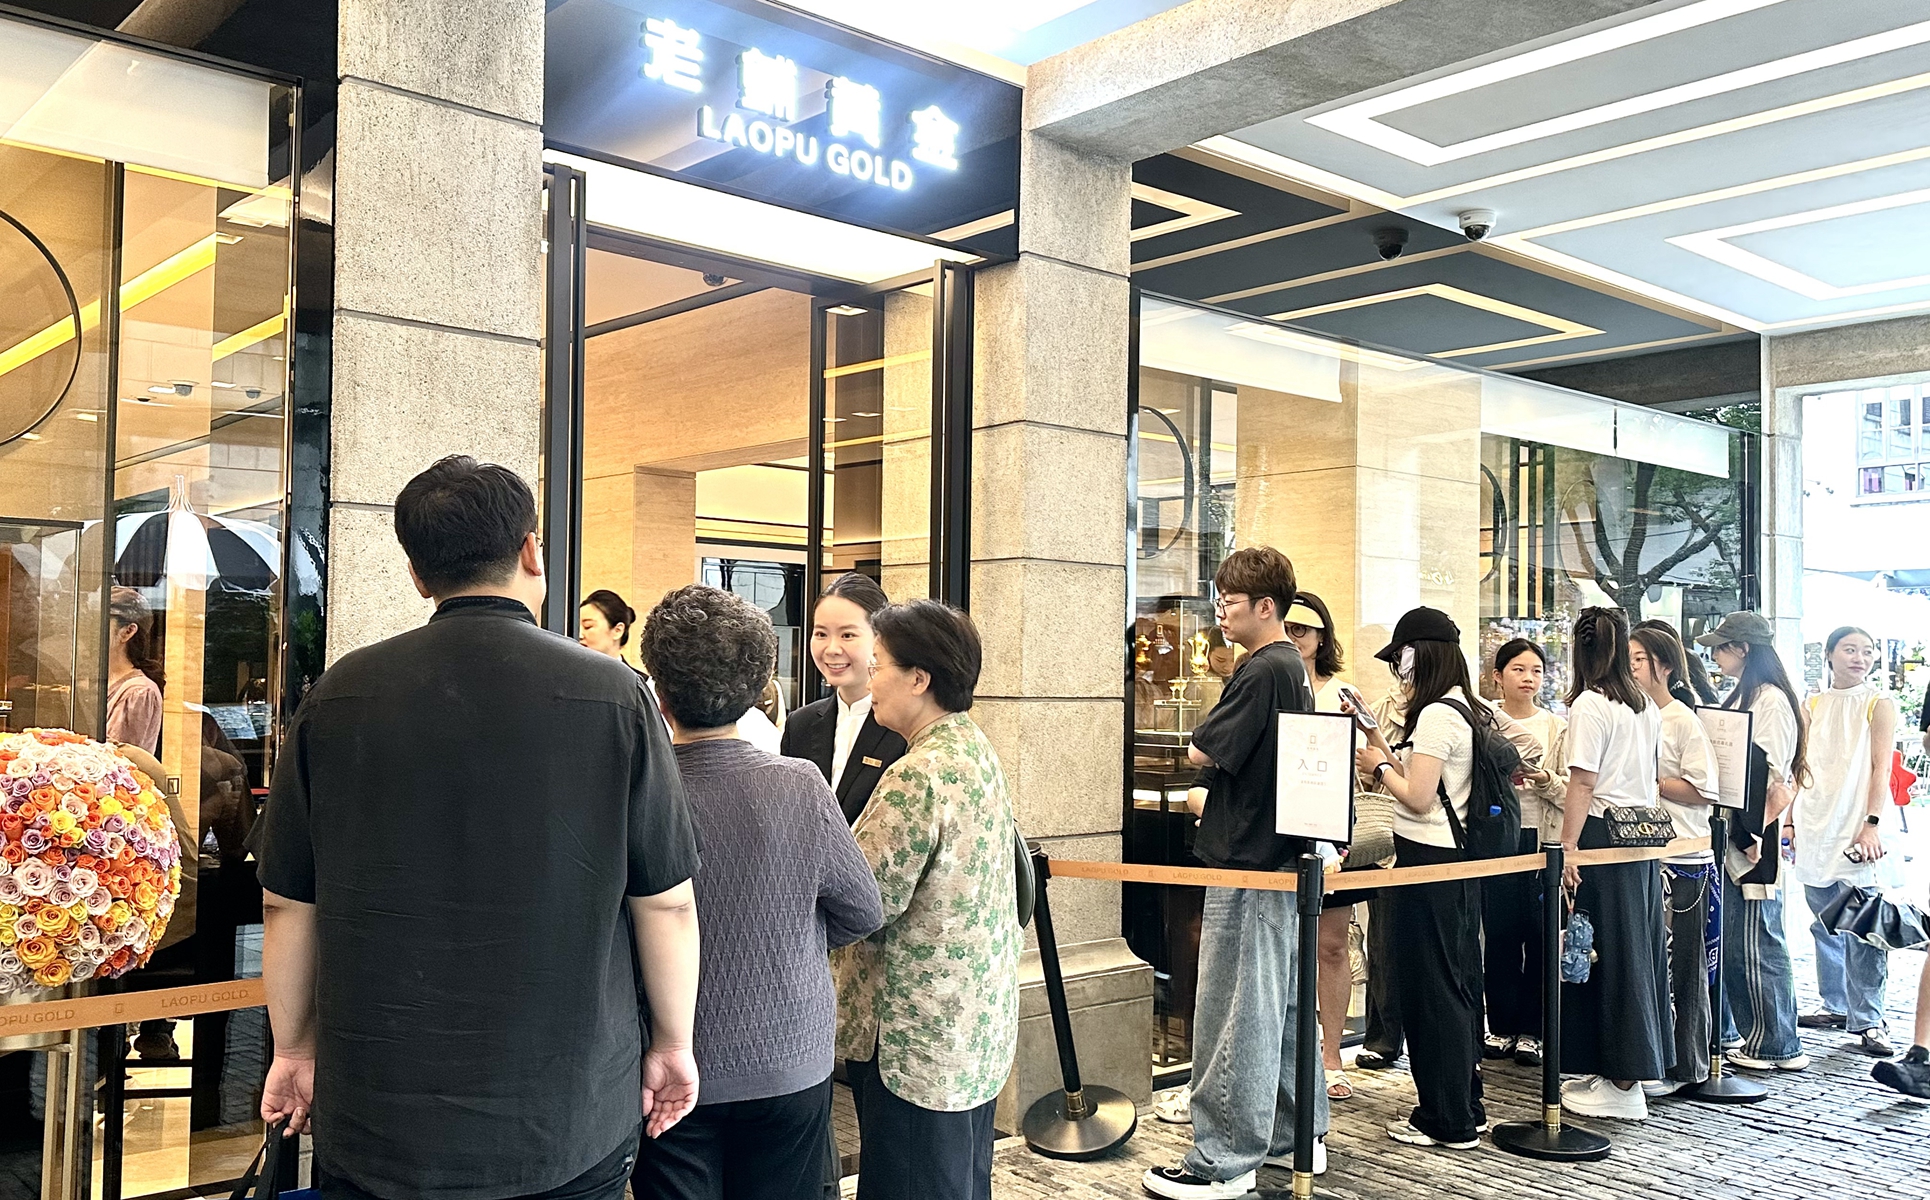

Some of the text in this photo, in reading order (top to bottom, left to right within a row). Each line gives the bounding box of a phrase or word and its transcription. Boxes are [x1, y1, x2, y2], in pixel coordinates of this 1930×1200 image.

[699, 105, 913, 191] LAOPU GOLD
[1297, 758, 1327, 772] 入口
[1107, 867, 1129, 875] GOLD
[1172, 872, 1222, 881] LAOPU GOLD
[1268, 877, 1296, 886] LAOPU
[161, 988, 249, 1009] LAOPU GOLD
[33, 1009, 75, 1023] GOLD
